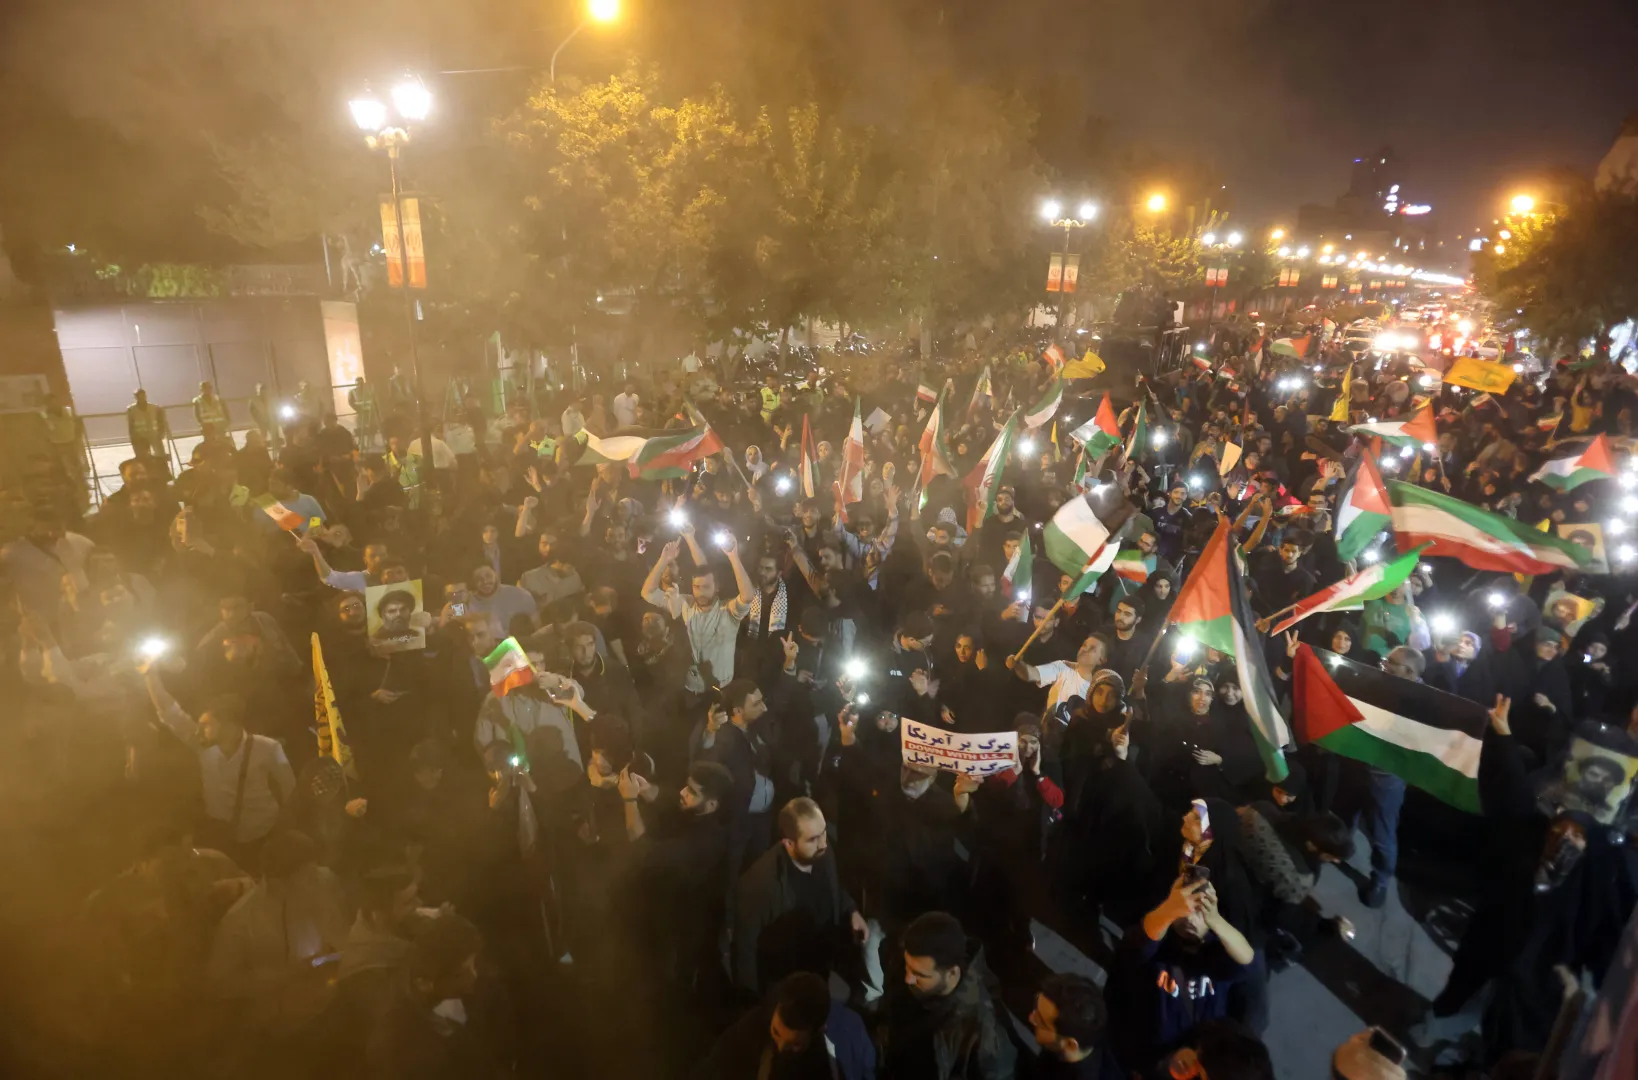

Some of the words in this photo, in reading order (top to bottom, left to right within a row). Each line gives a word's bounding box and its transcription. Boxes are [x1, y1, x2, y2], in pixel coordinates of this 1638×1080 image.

[908, 743, 944, 756] DOWN
[946, 750, 977, 760] WITH
[958, 741, 971, 752] بر
[978, 739, 1010, 752] مرگ
